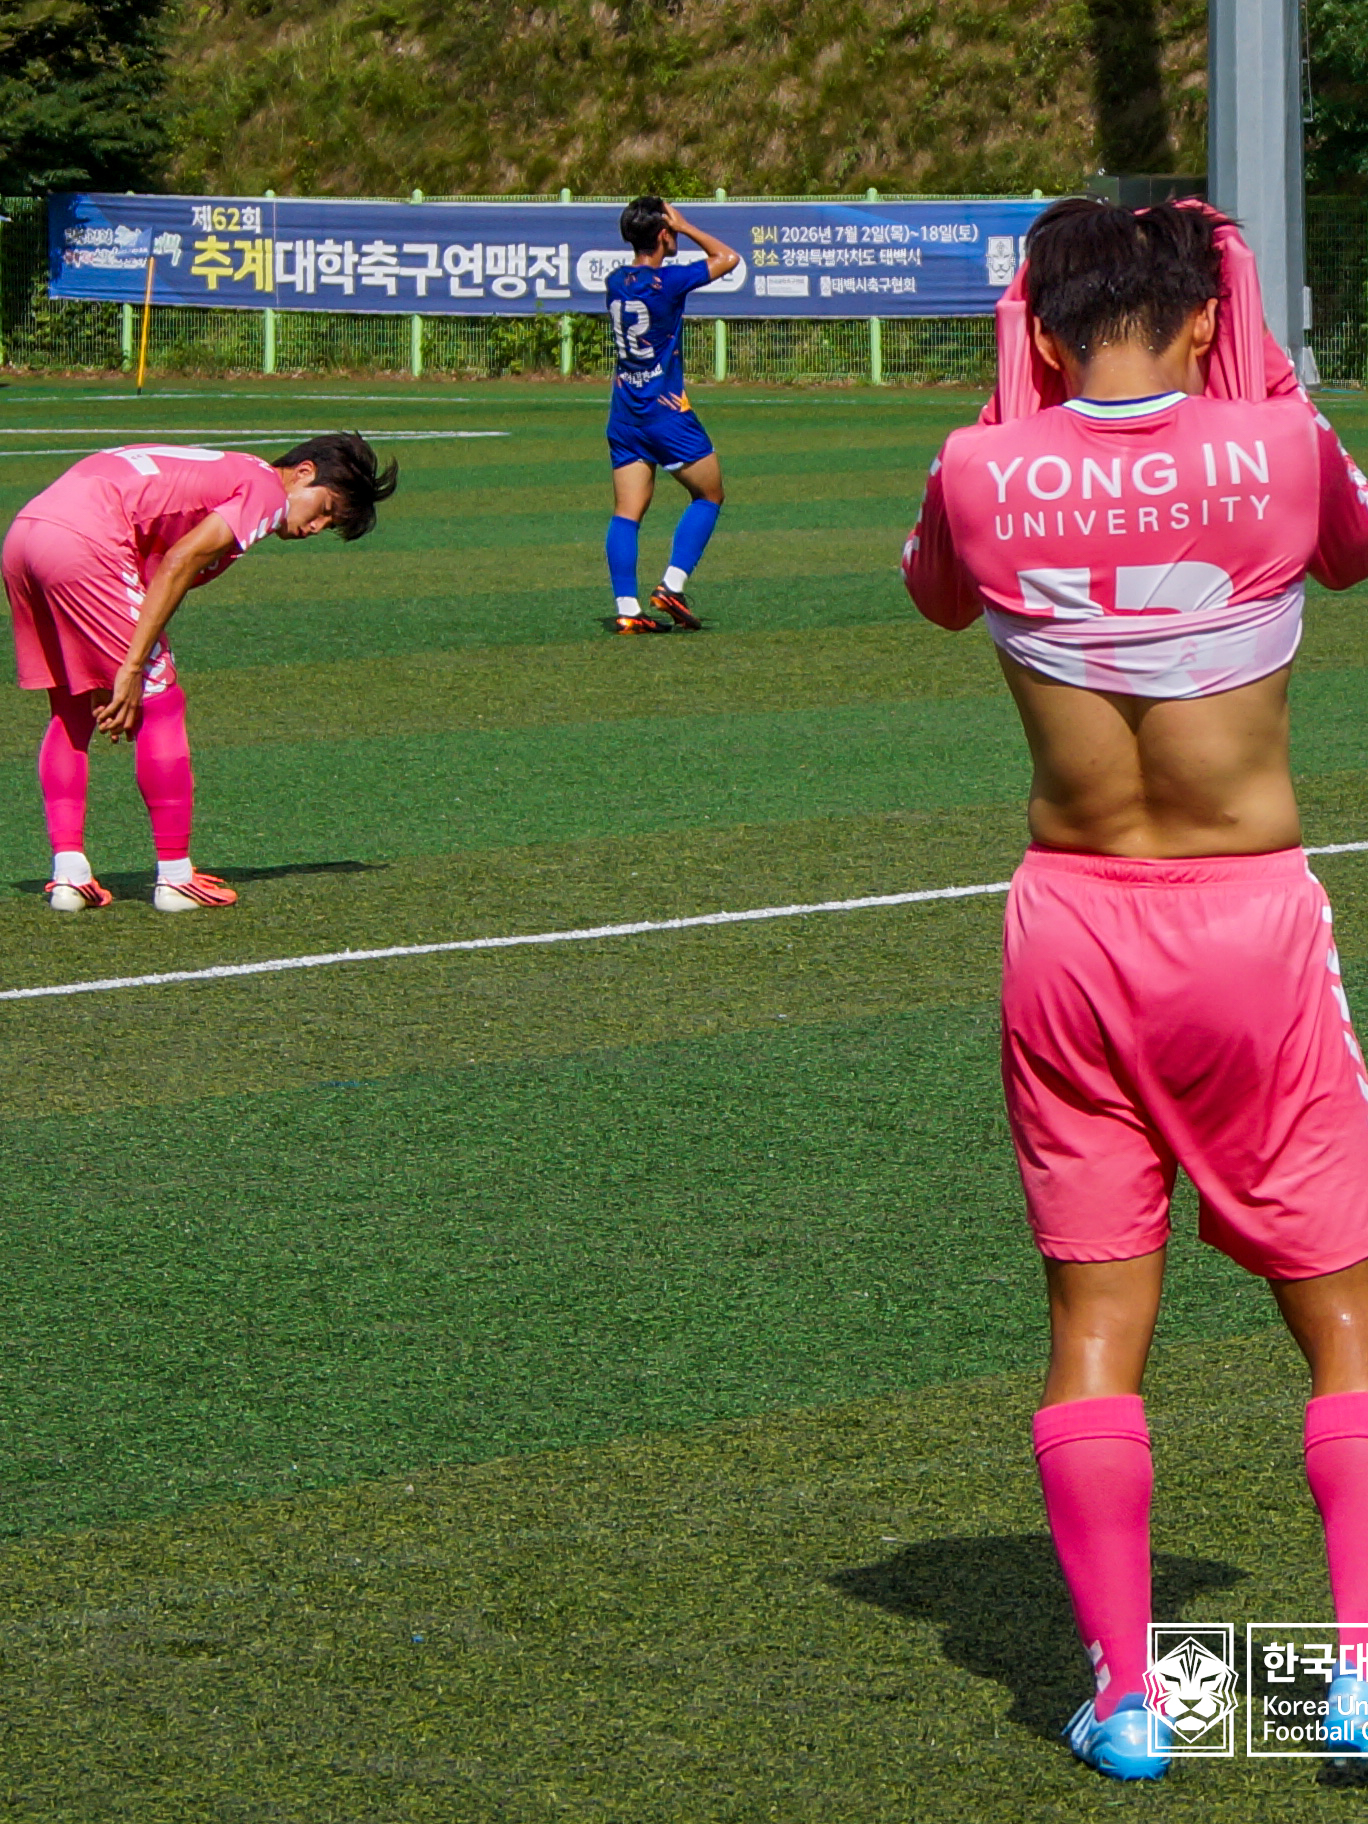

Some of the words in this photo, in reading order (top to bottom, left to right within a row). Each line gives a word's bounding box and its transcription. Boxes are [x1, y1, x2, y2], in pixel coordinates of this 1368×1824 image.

[191, 205, 261, 233] 제62회
[752, 226, 778, 243] 일시
[781, 226, 832, 243] 2026년
[835, 226, 858, 243] 7월
[191, 235, 571, 299] 추계대학축구연맹전
[752, 249, 779, 267] 장소
[782, 248, 877, 267] 강원특별자치도
[880, 248, 922, 266] 태백시
[609, 299, 655, 360] 12
[986, 452, 1178, 504] YONG
[1202, 440, 1270, 487] IN
[995, 494, 1271, 541] UNIVERSITY
